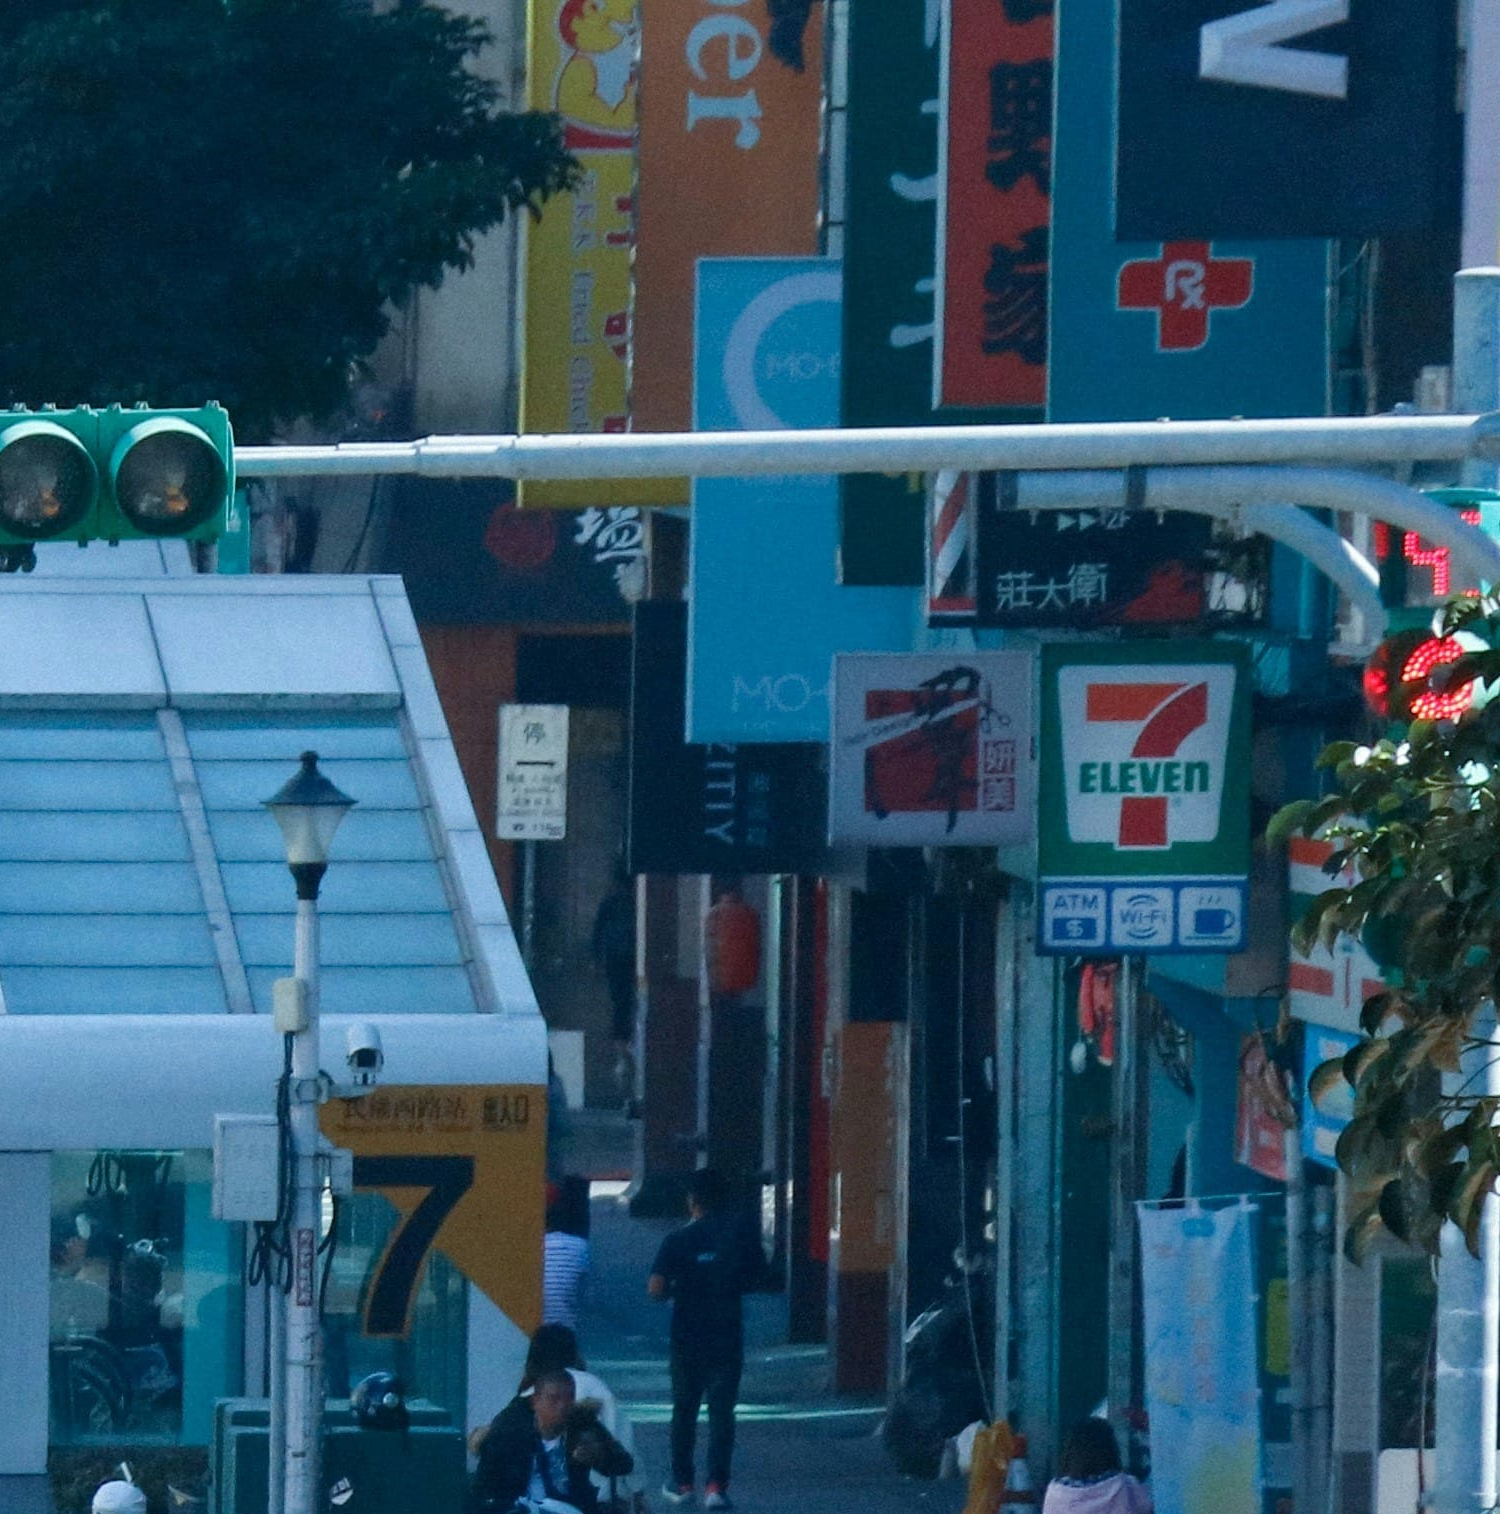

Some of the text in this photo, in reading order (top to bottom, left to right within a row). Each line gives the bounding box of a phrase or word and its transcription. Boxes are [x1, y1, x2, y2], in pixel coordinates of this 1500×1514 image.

[685, 0, 762, 149] er
[996, 564, 1109, 613] 莊大衛
[1052, 893, 1100, 911] ATM
[352, 1155, 476, 1337] 7
